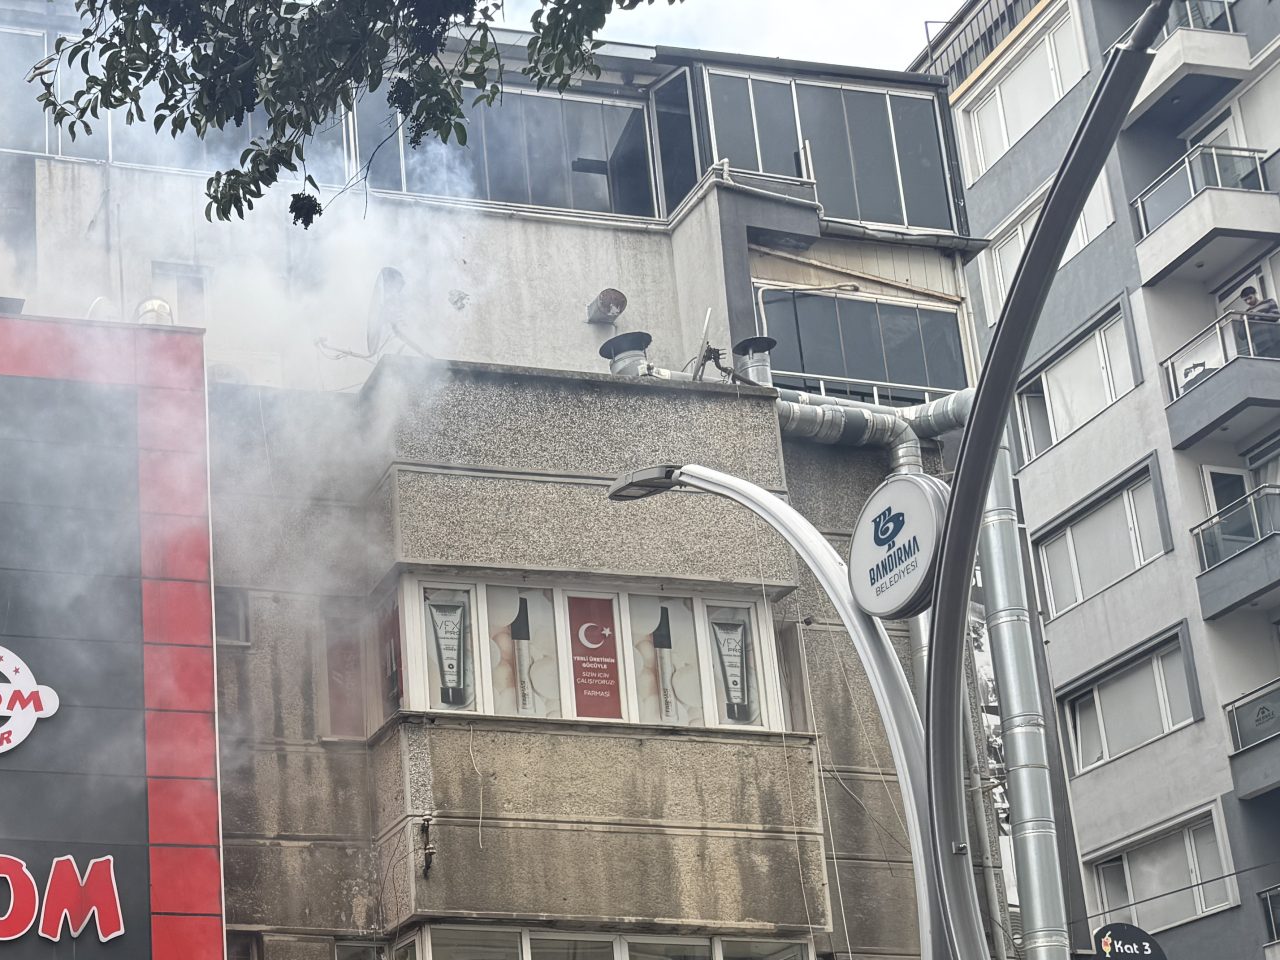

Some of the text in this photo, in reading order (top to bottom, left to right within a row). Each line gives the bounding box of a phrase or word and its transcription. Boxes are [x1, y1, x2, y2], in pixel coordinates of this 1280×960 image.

[869, 536, 920, 586] BANDIRMA
[875, 557, 918, 597] BELEDİYESİ
[1114, 940, 1152, 955] Kat 3
